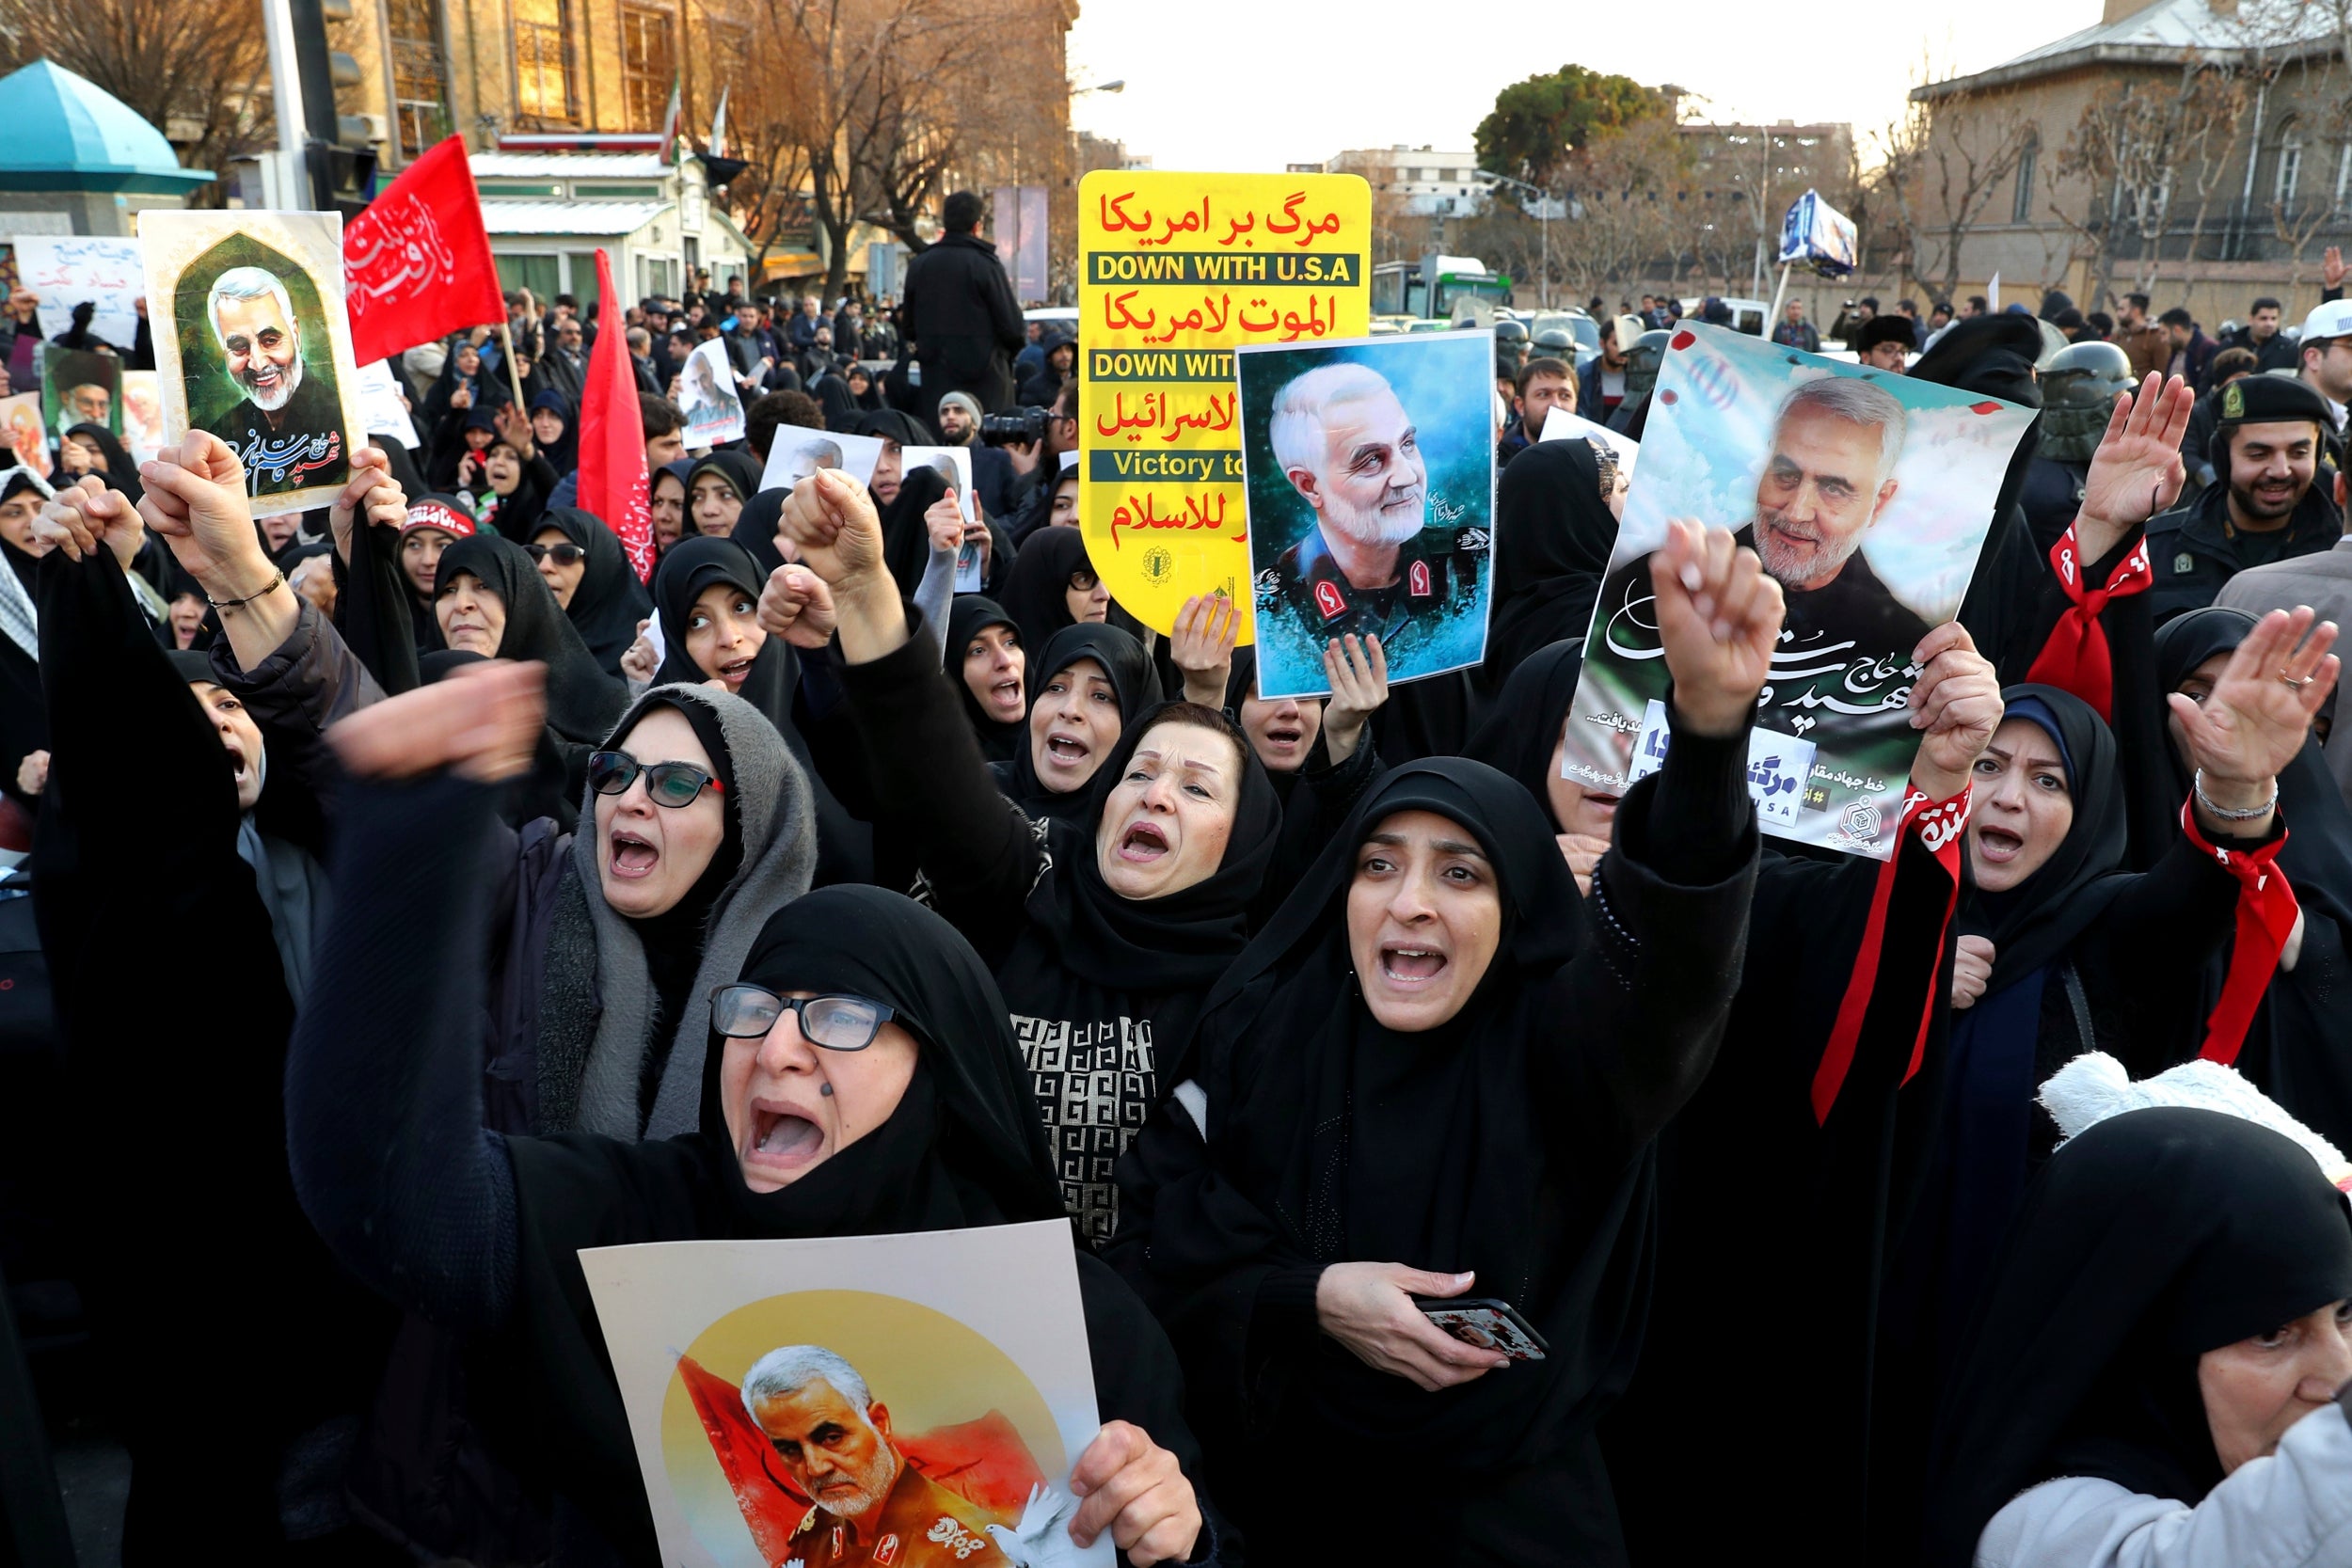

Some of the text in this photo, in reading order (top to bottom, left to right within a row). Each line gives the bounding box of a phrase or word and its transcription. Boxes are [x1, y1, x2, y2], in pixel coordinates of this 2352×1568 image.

[1099, 190, 1341, 248] مرگ بر امریکا
[1097, 255, 1350, 282] DOWN WITH U.S.A
[1238, 293, 1336, 343] الموت
[1094, 353, 1236, 377] DOWN WIT
[1113, 451, 1216, 482] Victory
[1109, 491, 1227, 552] للاسلام
[1864, 777, 1887, 792] خط
